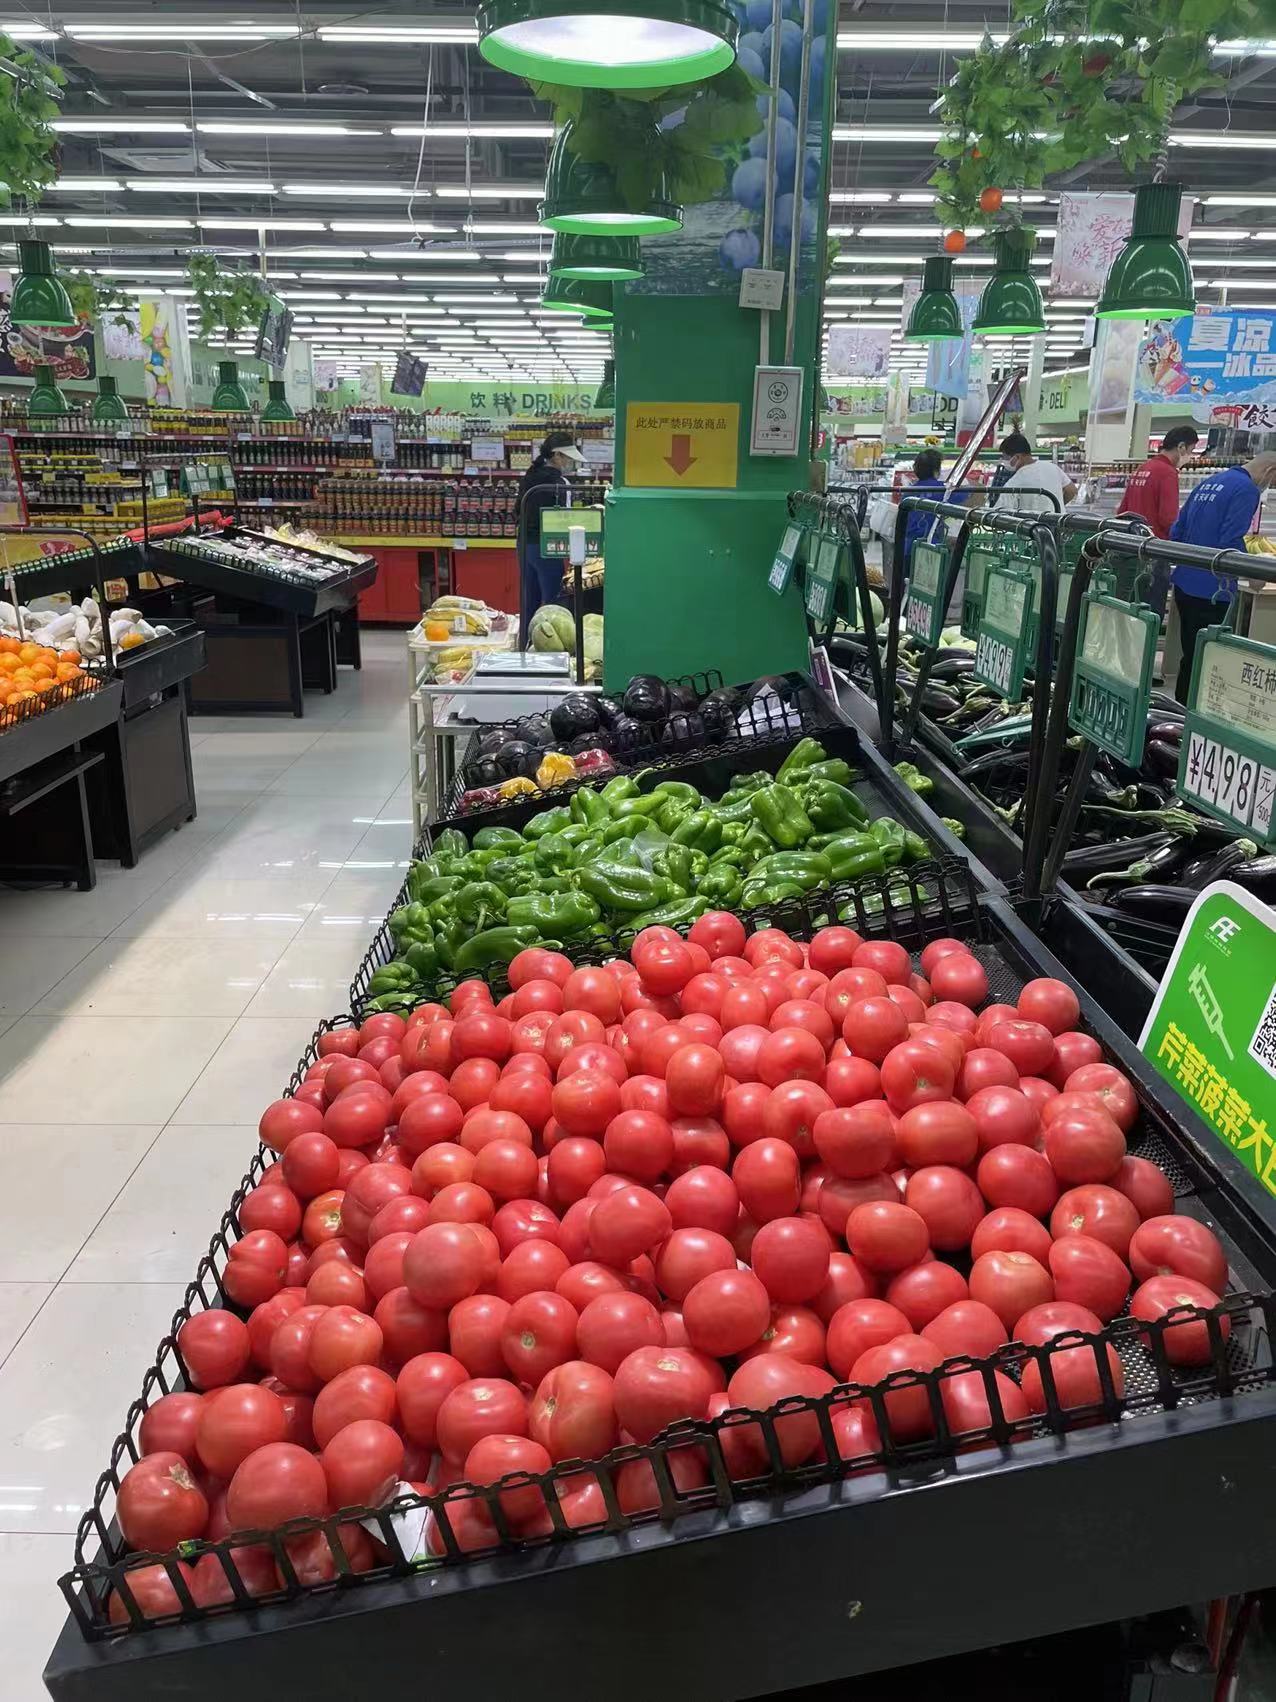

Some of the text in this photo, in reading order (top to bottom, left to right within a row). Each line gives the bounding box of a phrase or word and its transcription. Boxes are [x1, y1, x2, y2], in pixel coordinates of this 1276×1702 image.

[522, 393, 593, 409] DRINKS
[636, 417, 727, 429] 此处严禁码放商品
[1241, 662, 1276, 693] 西红柿
[1189, 738, 1252, 811] ¥4.98
